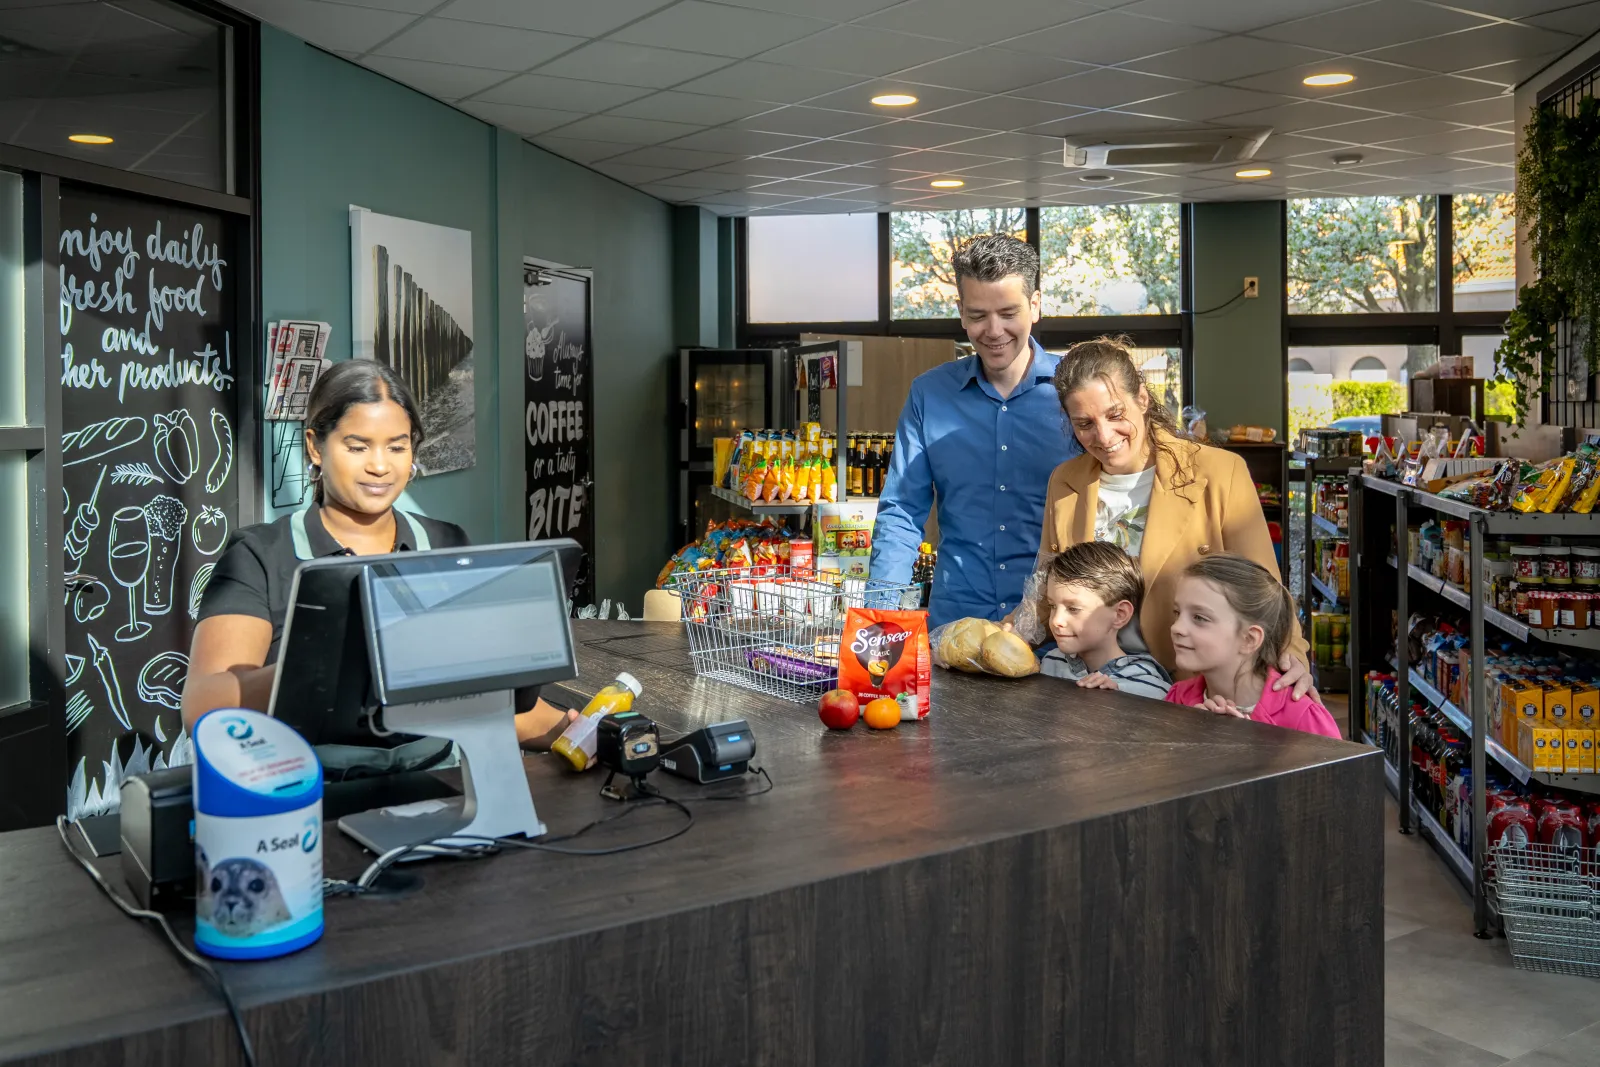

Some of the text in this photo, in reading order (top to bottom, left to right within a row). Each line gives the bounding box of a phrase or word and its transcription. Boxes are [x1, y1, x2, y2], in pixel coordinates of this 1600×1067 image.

[146, 219, 227, 291] daily
[59, 264, 207, 336] fresh food
[101, 311, 160, 356] and
[552, 330, 584, 374] Always
[60, 330, 235, 405] her products!
[553, 366, 584, 397] time for
[525, 400, 584, 446] COFFEE
[533, 446, 577, 484] or a tasty
[528, 482, 584, 541] BITE
[850, 628, 912, 654] Senseo
[256, 833, 299, 854] A Seal
